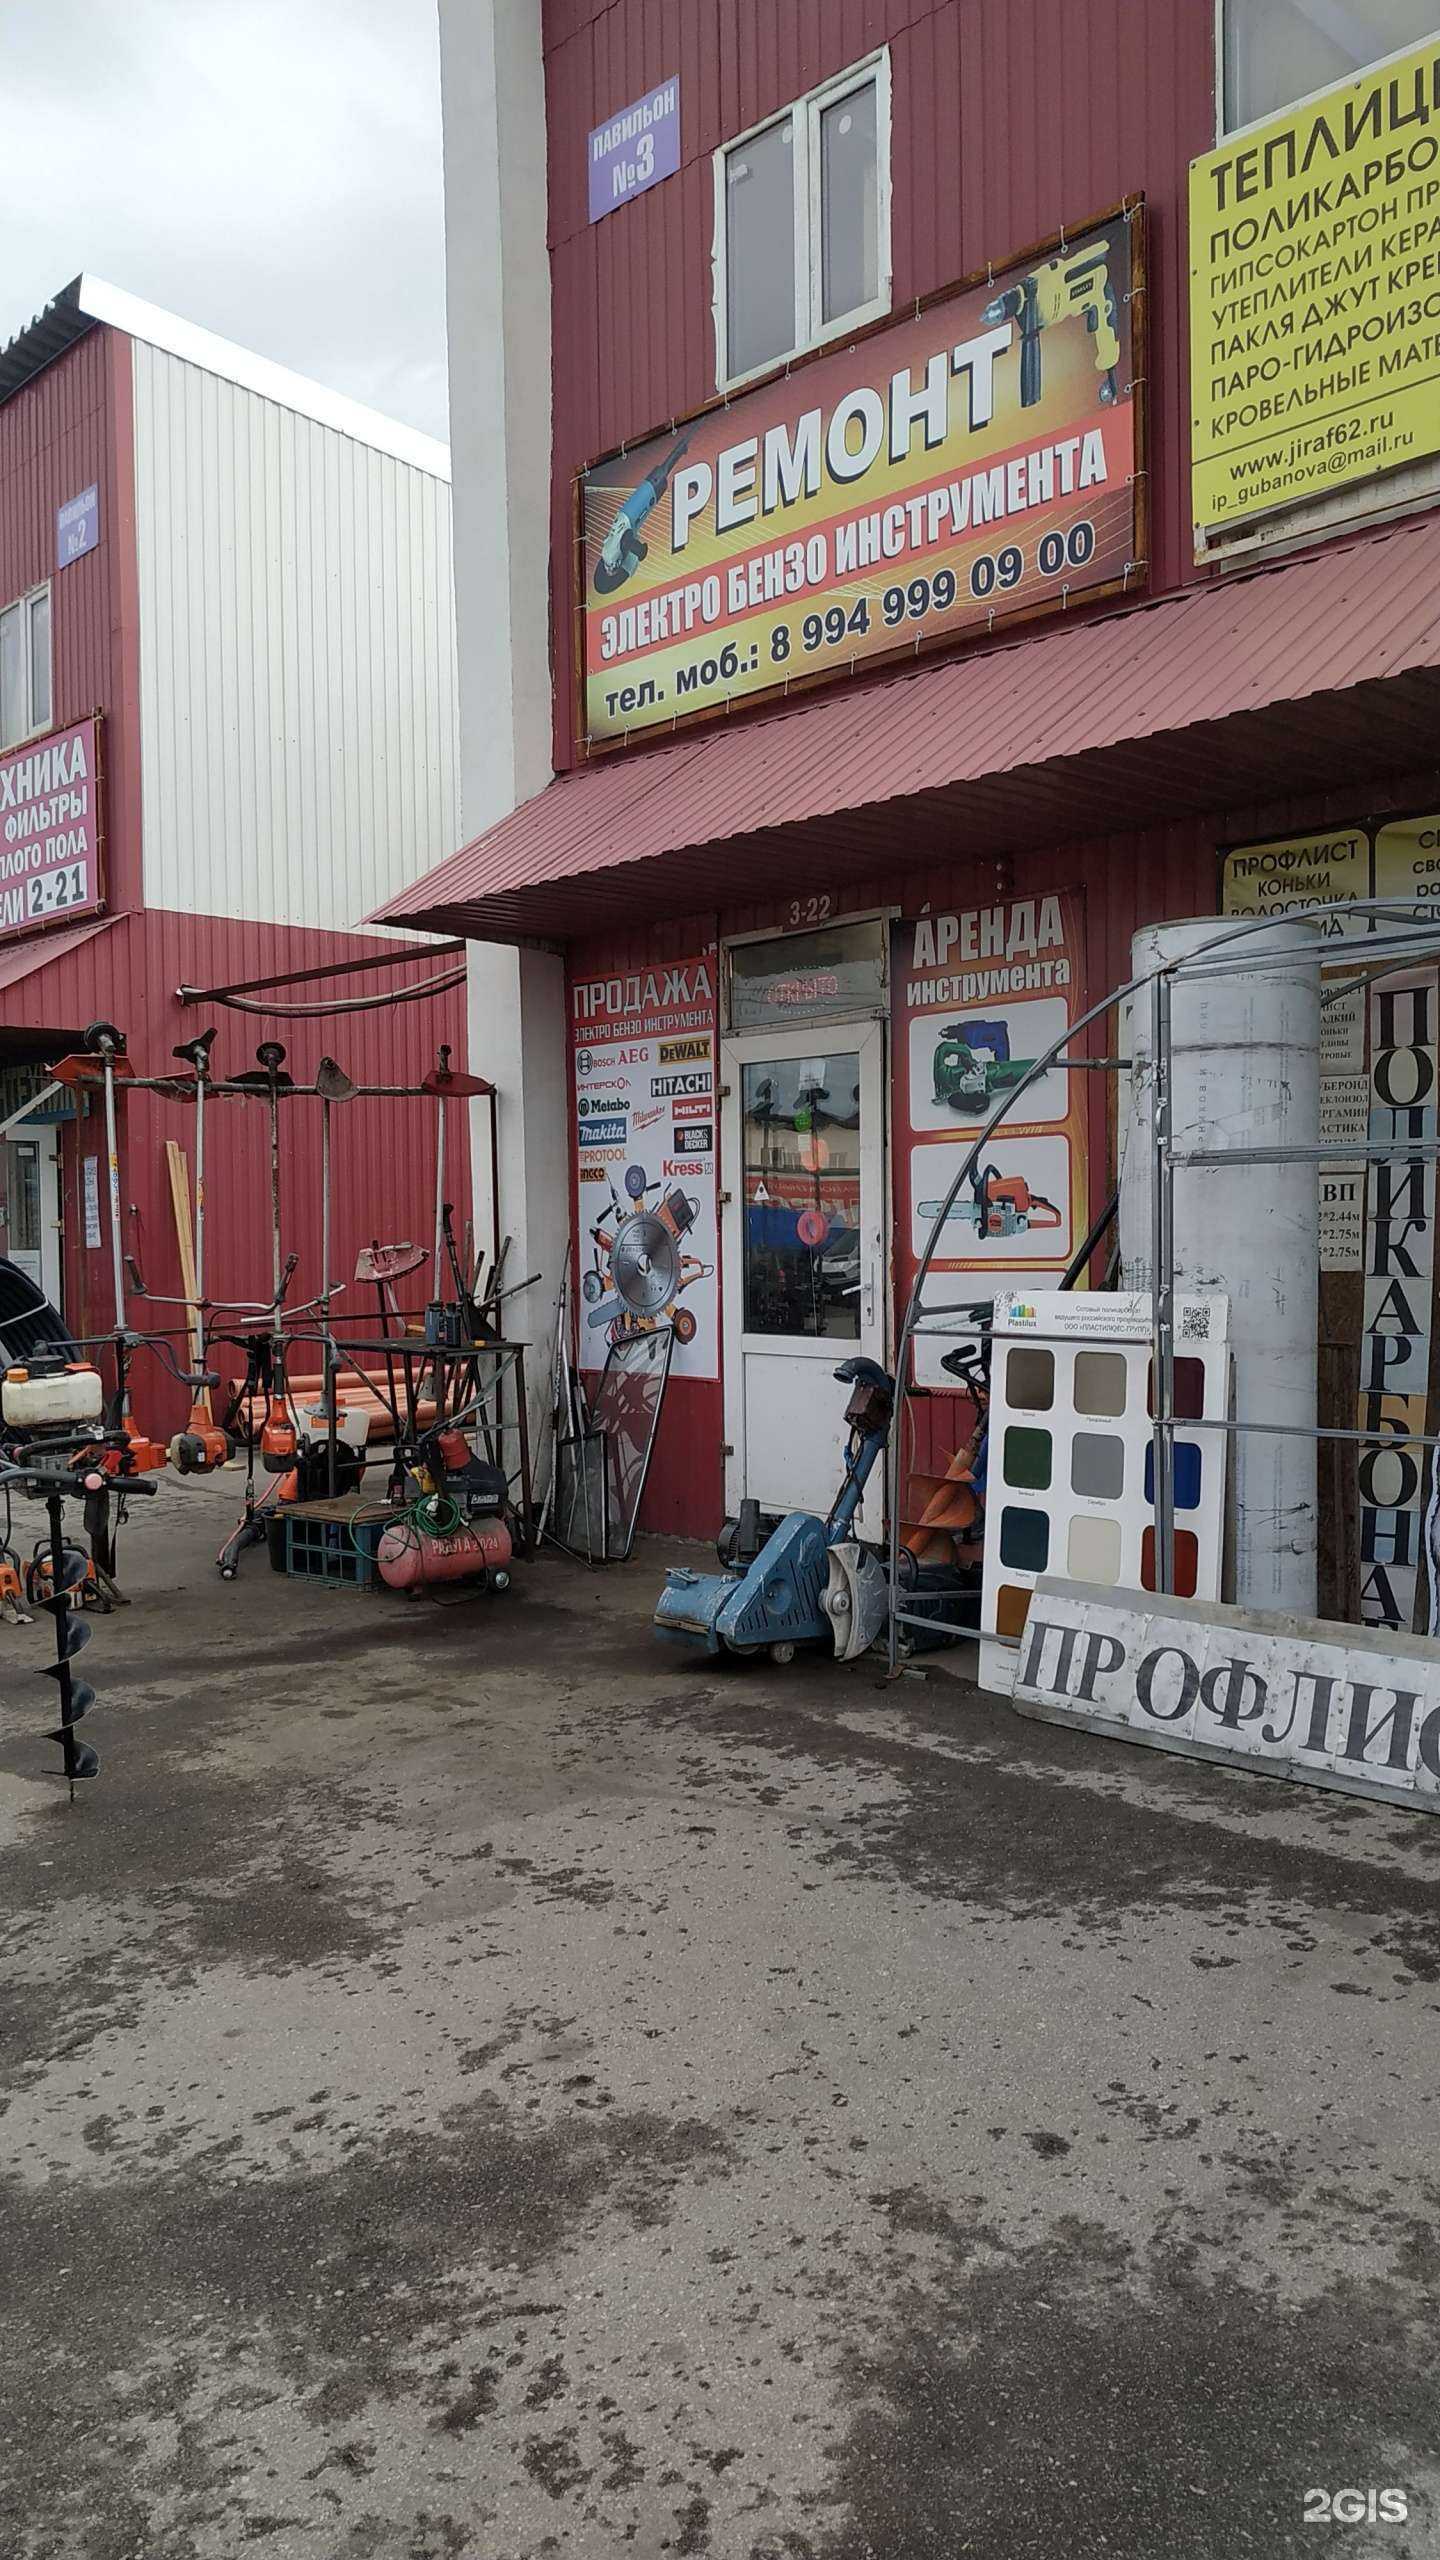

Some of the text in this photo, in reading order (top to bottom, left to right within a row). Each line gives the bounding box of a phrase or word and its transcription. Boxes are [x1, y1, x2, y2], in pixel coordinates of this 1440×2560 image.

[593, 86, 675, 162] ПАВИЛЬОН
[612, 133, 655, 198] №3
[1210, 136, 1439, 264] ПОЛИКАРБО
[1211, 197, 1398, 299] ГИПСОКАРТОН
[1211, 250, 1440, 365] ПАКЛЯ ДЖУТ КРЕ
[1212, 245, 1372, 330] УТЕПЛИТЕЛИ
[1212, 360, 1371, 439] КРОВЕЛЬНЫЕ
[671, 322, 1013, 554] РЕМОНТ
[1230, 411, 1394, 481] www.jiraf62.ru
[1212, 431, 1414, 512] ip_gubanova@mail.ru
[600, 428, 1108, 662] ЭЛЕКТРО БЕНЗО ИНСТРУМЕНТА
[605, 520, 1095, 717] тел. моб.: 8 994 999 09 00
[5, 785, 88, 843] ФИЛЬТРЫ
[46, 826, 88, 864] ПОЛА
[1233, 839, 1359, 878] ПРОФЛИСТ
[31, 864, 85, 914] 2-21
[789, 895, 831, 925] 3-22
[1258, 871, 1331, 897] КОНЬКИ
[912, 896, 1065, 970] АРЕНДА
[573, 965, 713, 1019] ПРОДАЖА
[907, 957, 1071, 1007] инструмента
[575, 1009, 714, 1043] ЭЛЕКТРО БЕНЗО ИНСТРУМЕНТА
[577, 1077, 631, 1092] ИНТЕРСКОЛ
[594, 1057, 616, 1068] BOSCH
[618, 1046, 649, 1065] AEG
[652, 1073, 711, 1096] HITACHI
[591, 1098, 631, 1114] Metabo
[674, 1103, 711, 1116] HILTI
[662, 1160, 704, 1176] Kress
[1008, 1318, 1037, 1328] Plastilux
[1359, 986, 1436, 1632] ПОЛИКАРБОНА
